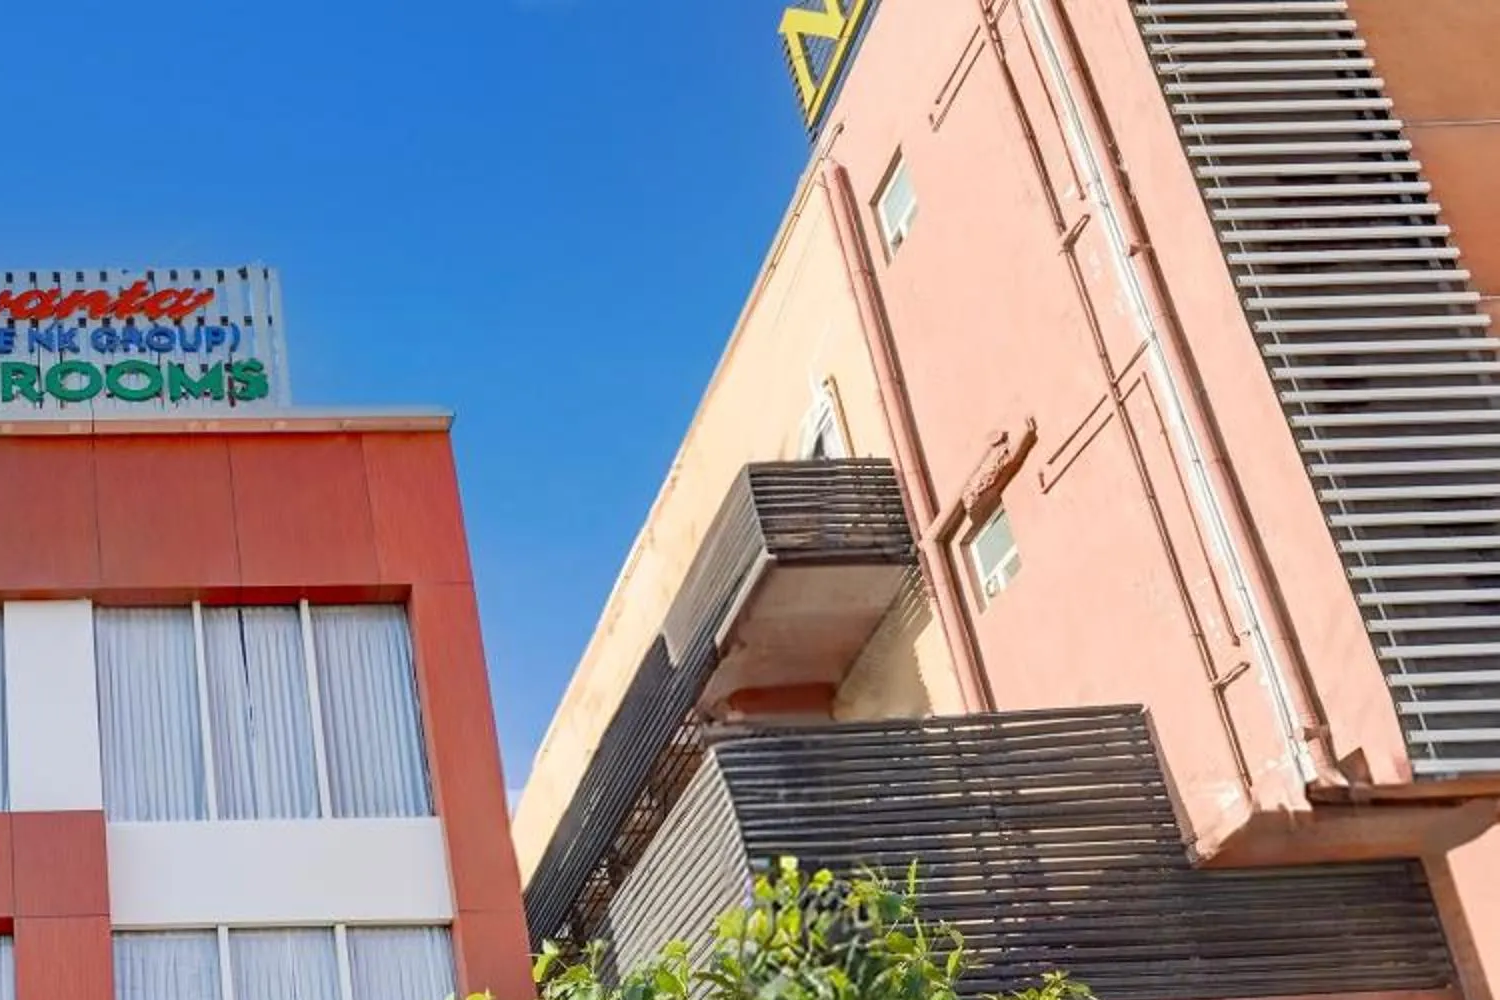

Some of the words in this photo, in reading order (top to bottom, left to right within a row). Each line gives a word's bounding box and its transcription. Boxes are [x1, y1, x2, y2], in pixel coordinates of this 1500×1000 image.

[28, 327, 81, 353] NK
[91, 322, 241, 353] GROUP)
[0, 357, 269, 403] ROOMS
